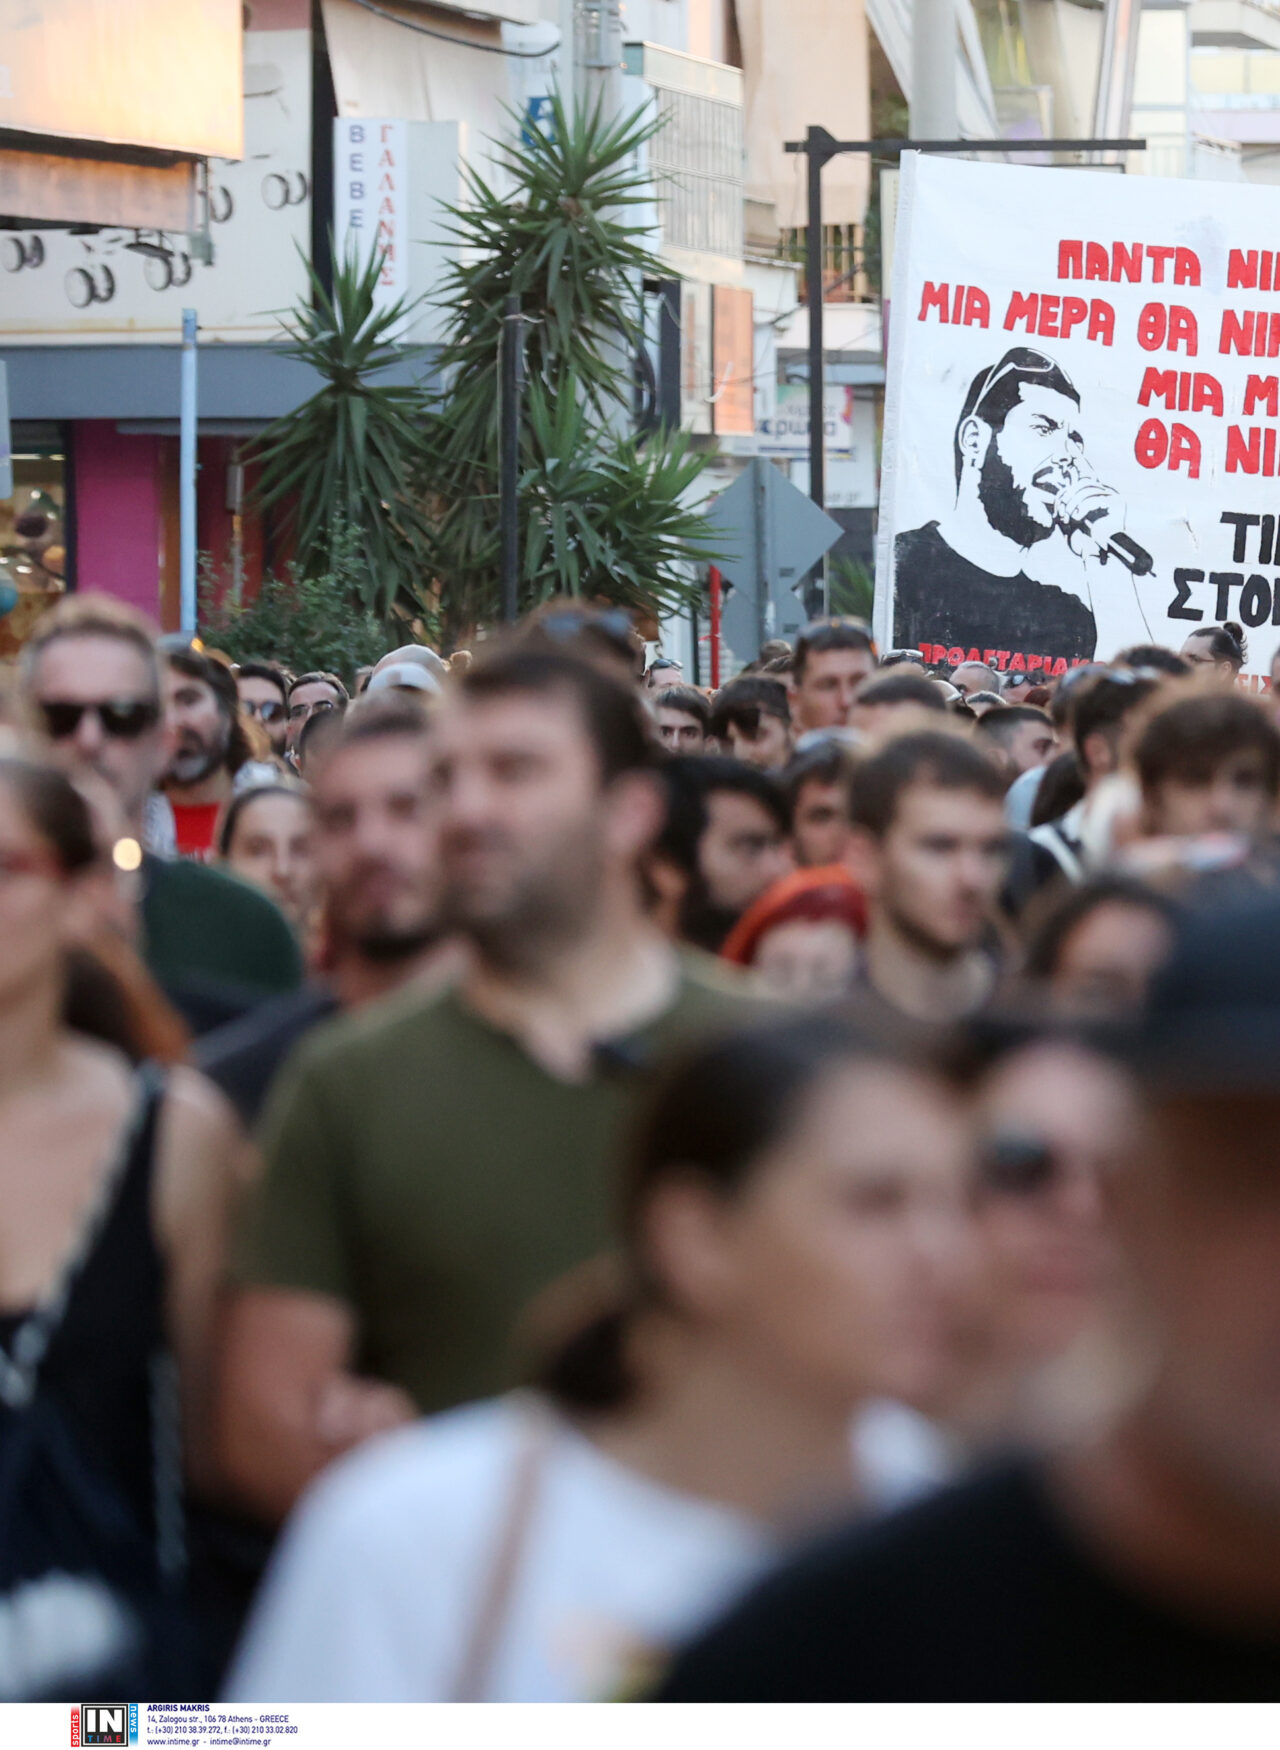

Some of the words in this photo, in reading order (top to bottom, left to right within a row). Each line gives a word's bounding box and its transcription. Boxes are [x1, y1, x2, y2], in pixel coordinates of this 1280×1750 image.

[1058, 240, 1201, 286] ΠΑΝΤΑ
[918, 281, 990, 328] ΜΙΑ
[1003, 290, 1115, 346] ΜΕΡΑ
[1137, 302, 1198, 356] ΘΑ
[1138, 367, 1223, 416] ΜΙΑ
[1135, 418, 1201, 479] ΘΑ
